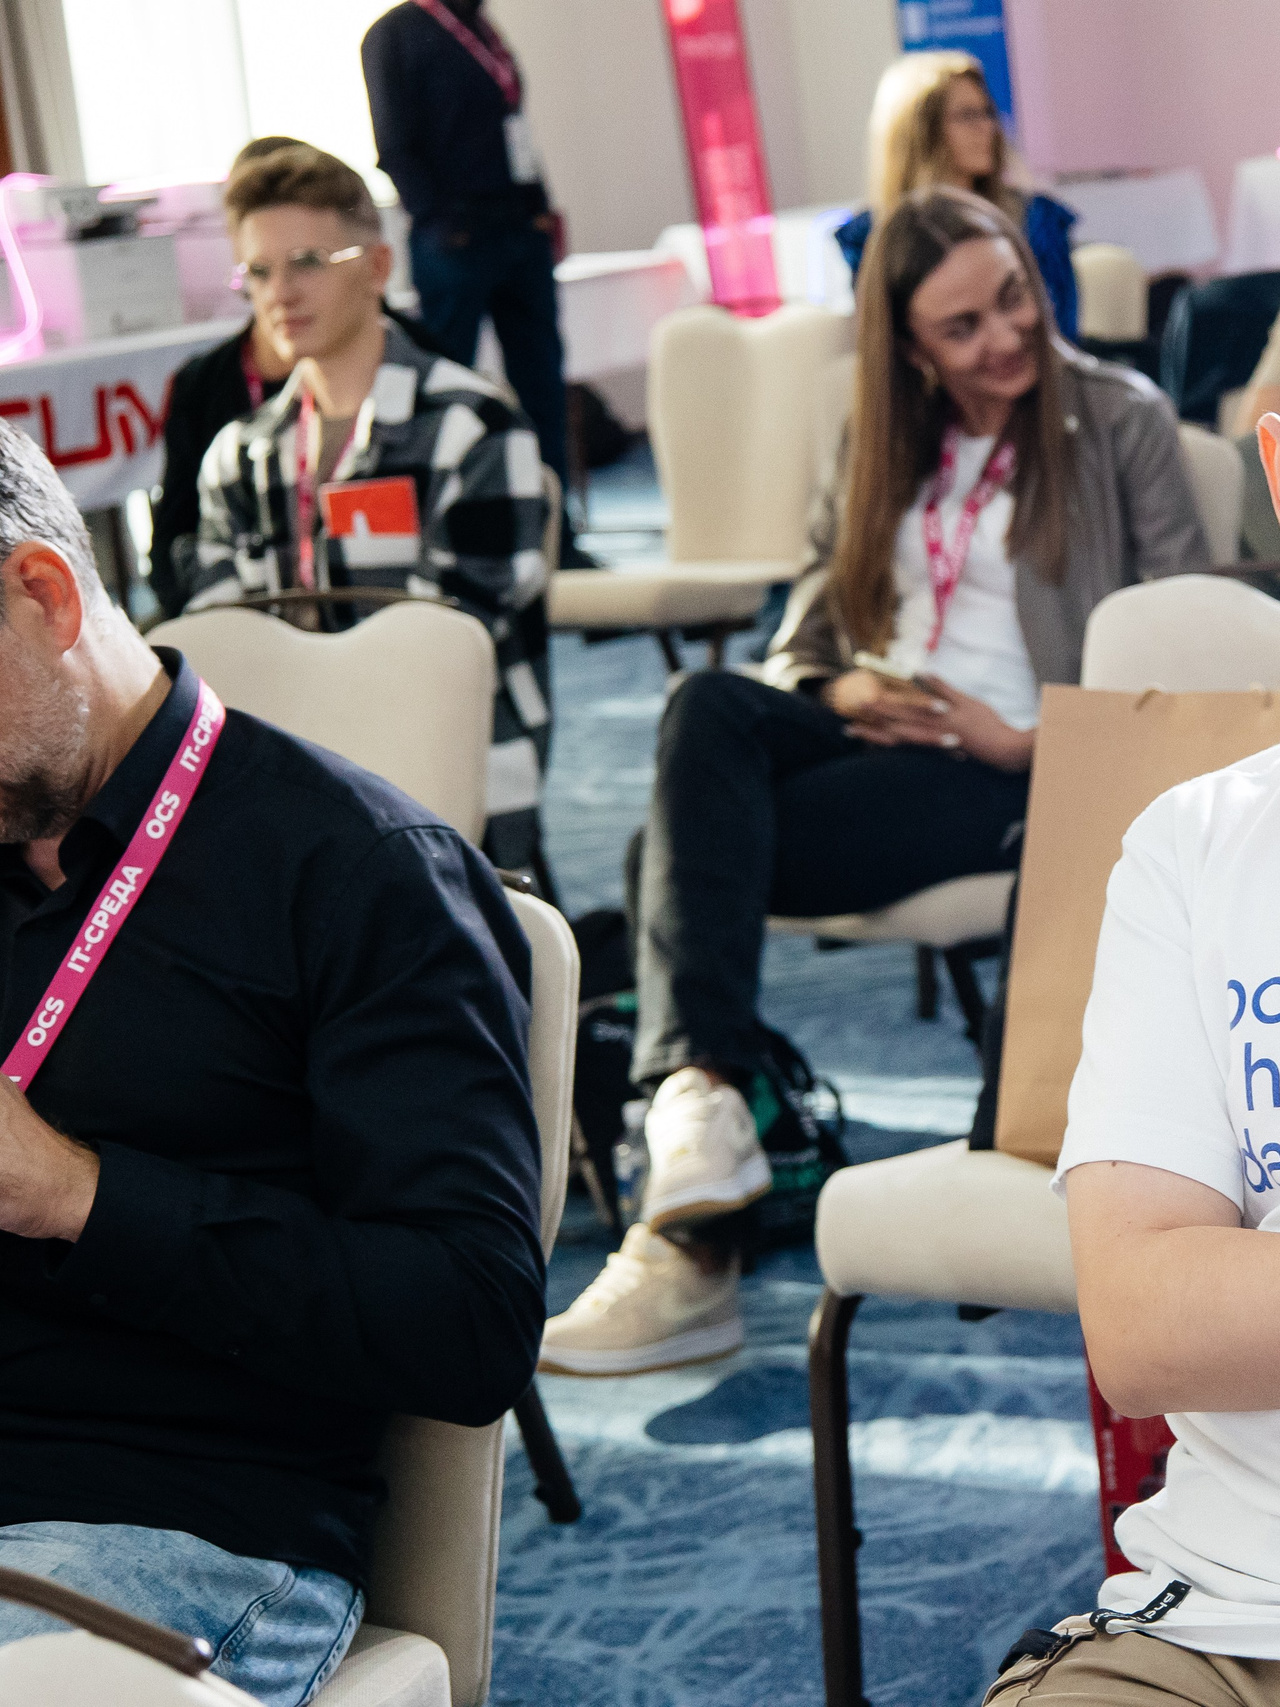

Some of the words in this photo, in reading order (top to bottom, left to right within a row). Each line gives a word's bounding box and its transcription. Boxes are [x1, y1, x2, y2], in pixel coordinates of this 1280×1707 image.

[27, 997, 65, 1047] OCS
[67, 865, 143, 974] IT-СРЕДА
[146, 790, 180, 839] OCS
